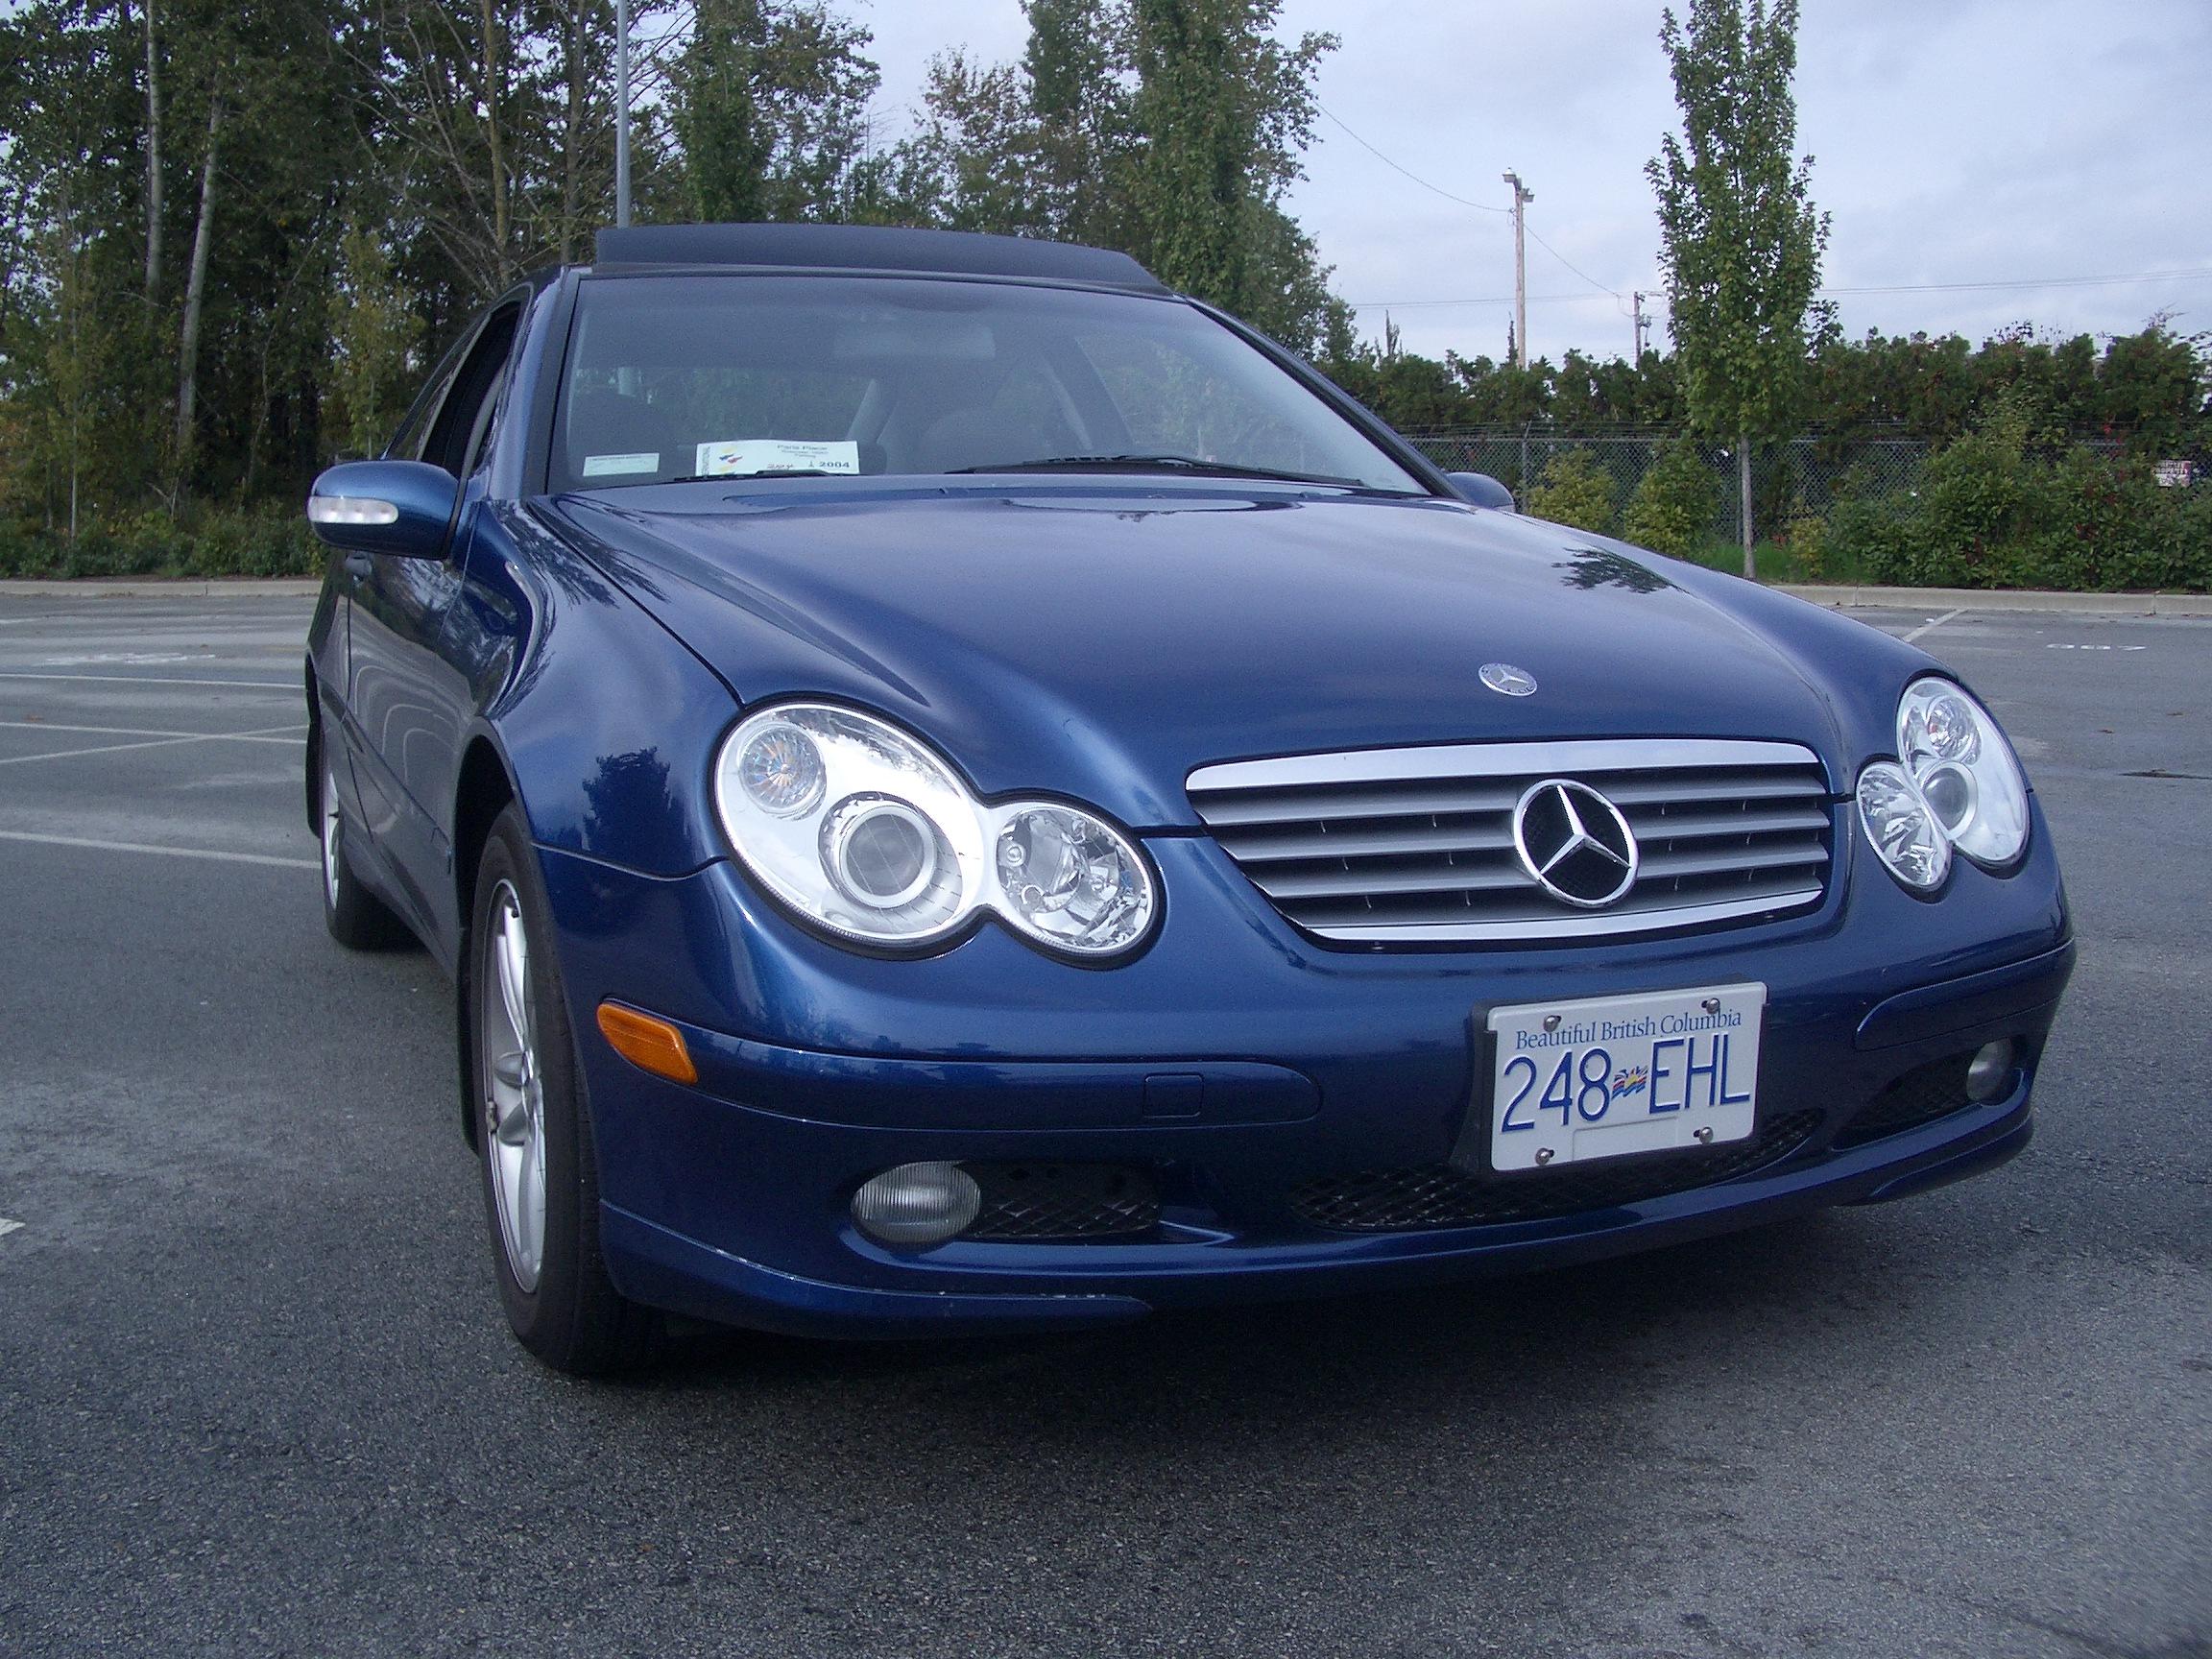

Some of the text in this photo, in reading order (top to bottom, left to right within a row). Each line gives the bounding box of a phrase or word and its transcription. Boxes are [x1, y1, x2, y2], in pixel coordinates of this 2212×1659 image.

[1516, 1008, 1742, 1050] Beautiful British Columbia
[1501, 1030, 1751, 1133] 248 EHL
